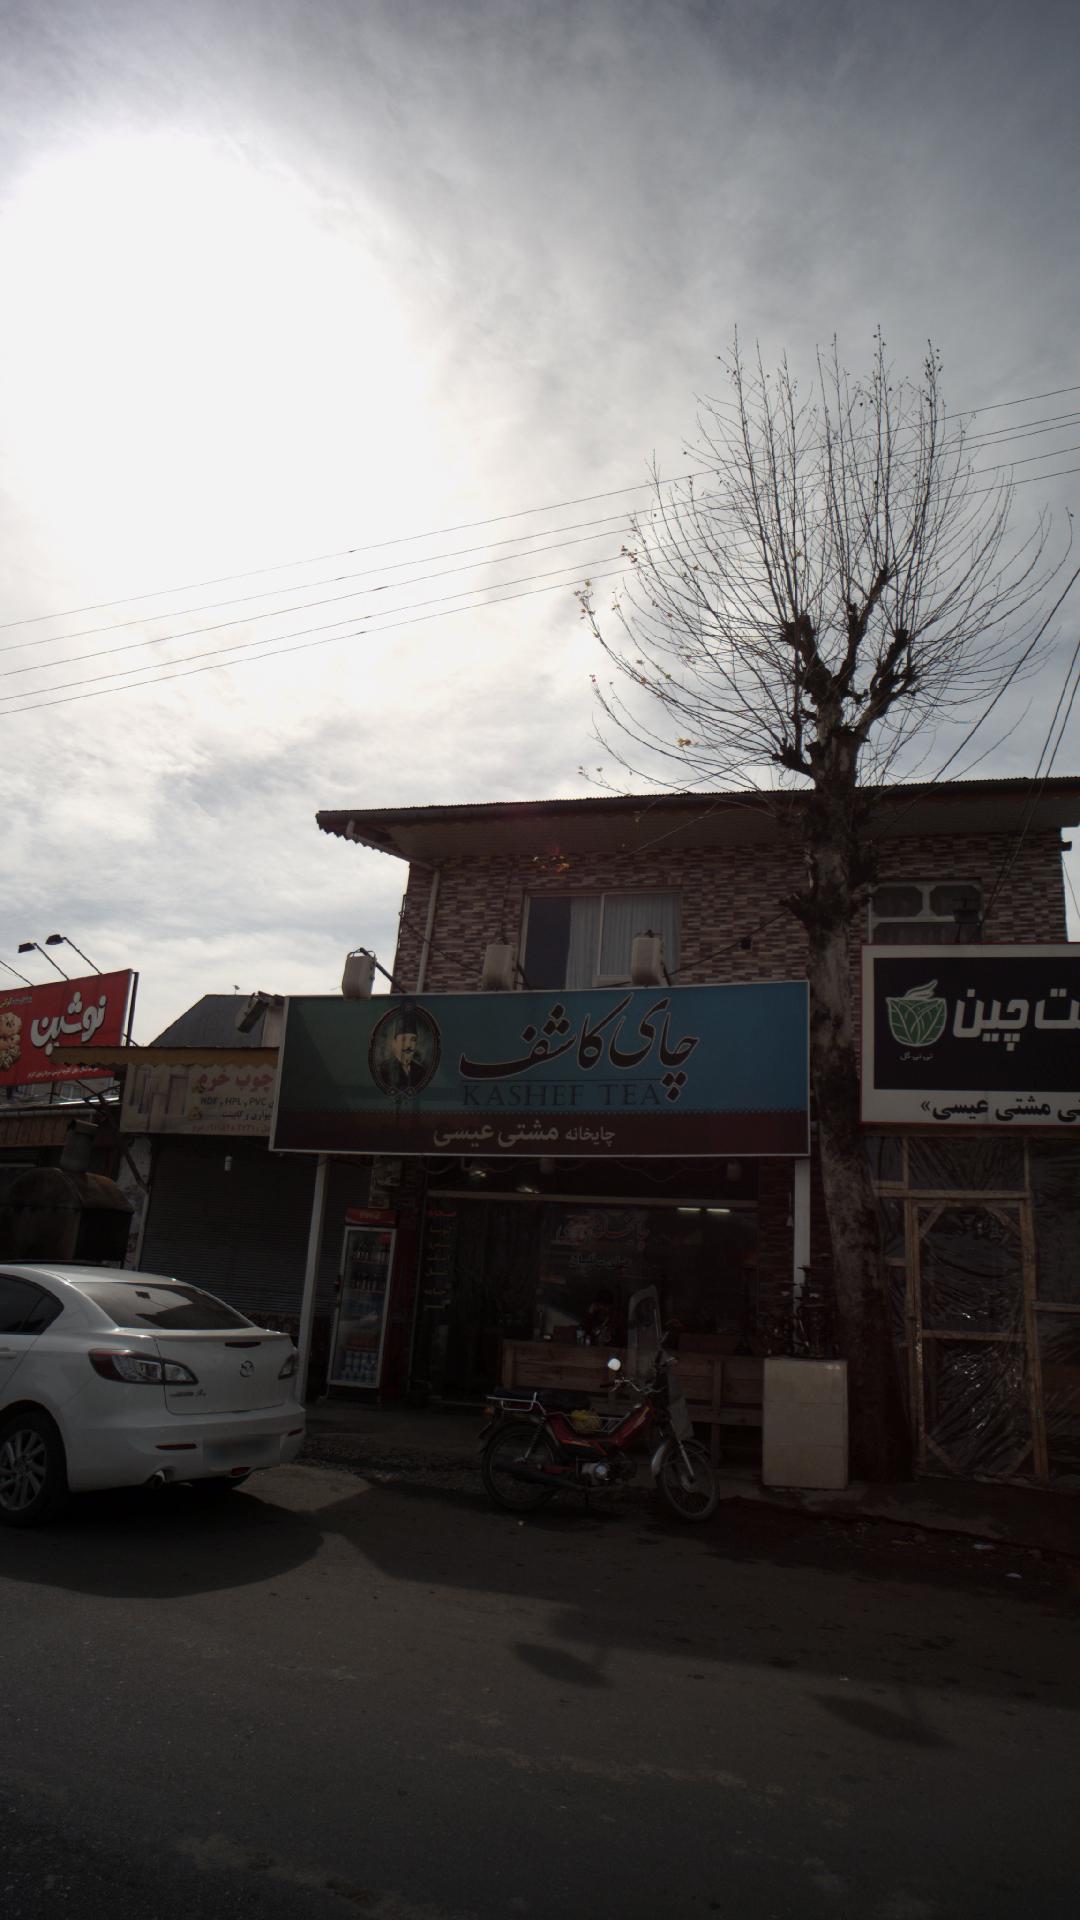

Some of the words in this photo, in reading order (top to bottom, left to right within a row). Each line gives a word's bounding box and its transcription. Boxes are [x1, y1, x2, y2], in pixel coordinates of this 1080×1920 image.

[31, 991, 107, 1056] نوشین
[953, 988, 1031, 1051] چین
[459, 992, 634, 1079] کاشف
[608, 997, 700, 1101] چای
[463, 1083, 585, 1106] KASHEF
[599, 1083, 662, 1106] TEA
[994, 1095, 1052, 1122] مشتی
[432, 1122, 495, 1148] عیسی
[497, 1119, 560, 1148] مشتی
[565, 1124, 616, 1148] چایخانه
